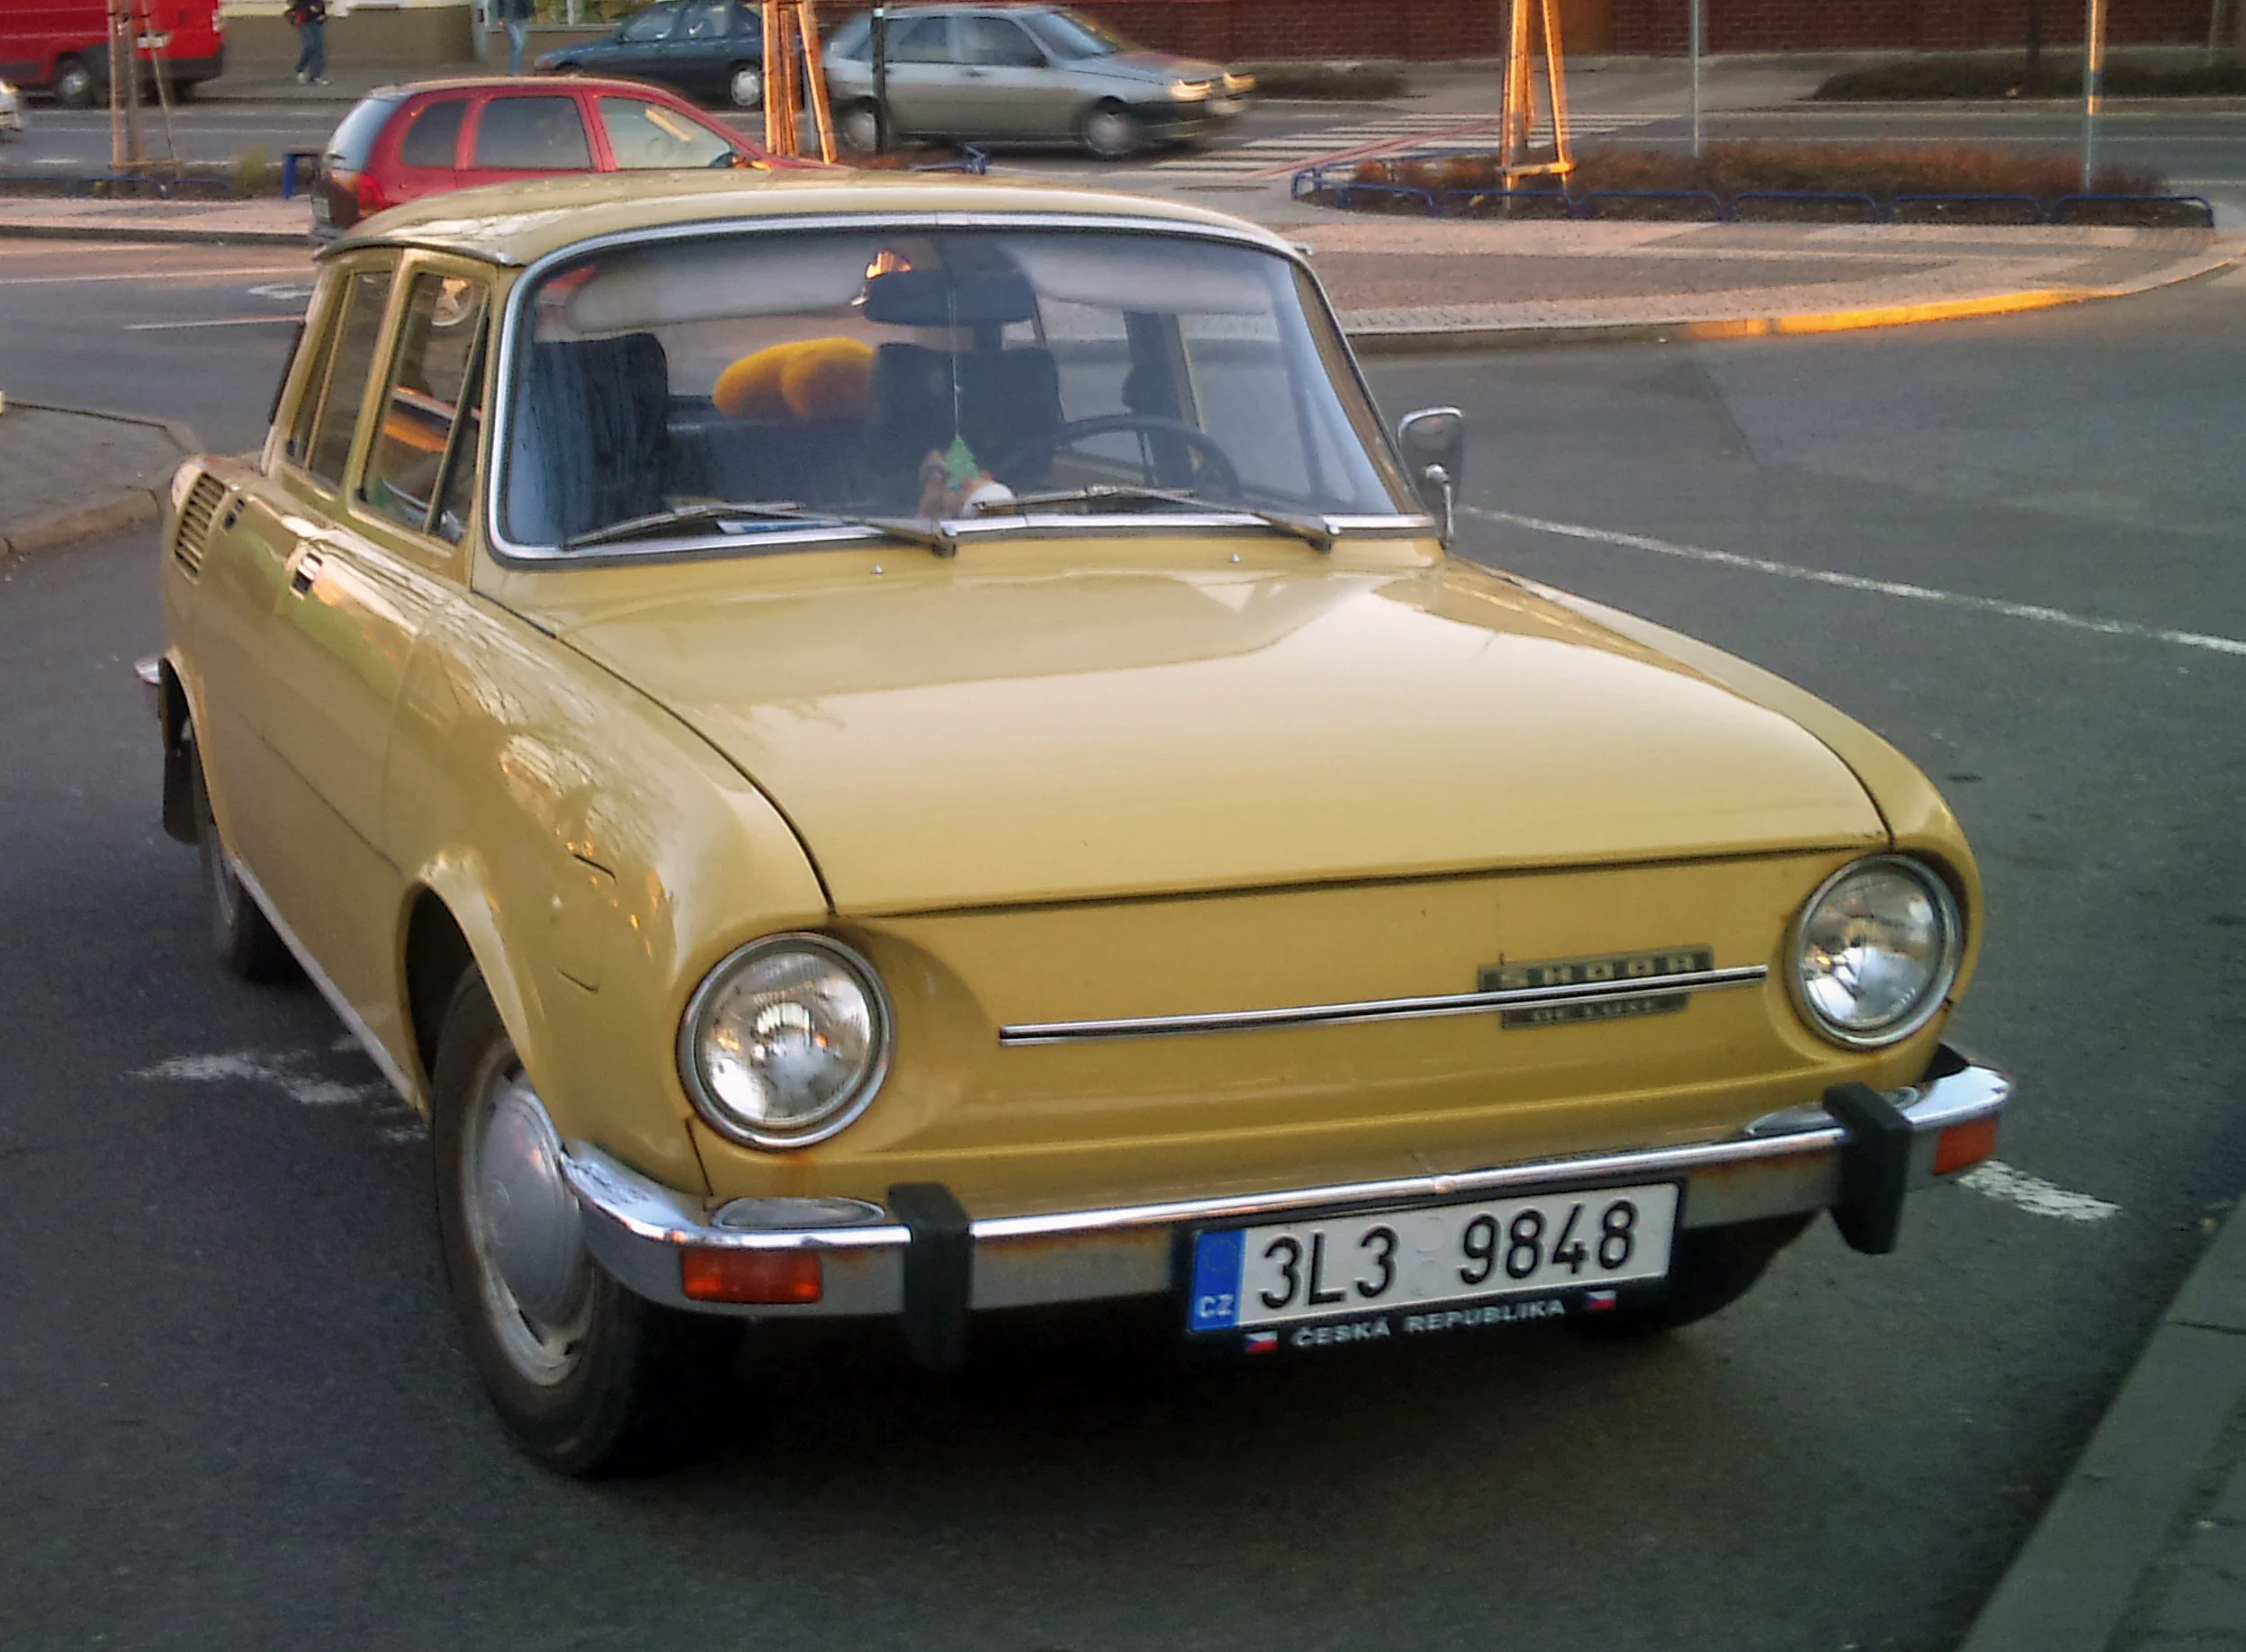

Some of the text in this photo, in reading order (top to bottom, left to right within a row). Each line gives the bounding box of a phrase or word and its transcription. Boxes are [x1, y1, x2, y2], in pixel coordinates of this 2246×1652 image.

[1261, 1199, 1639, 1310] 3L3 9848
[1195, 1293, 1234, 1318] CZ
[1403, 1298, 1566, 1333] REPUBLIKA
